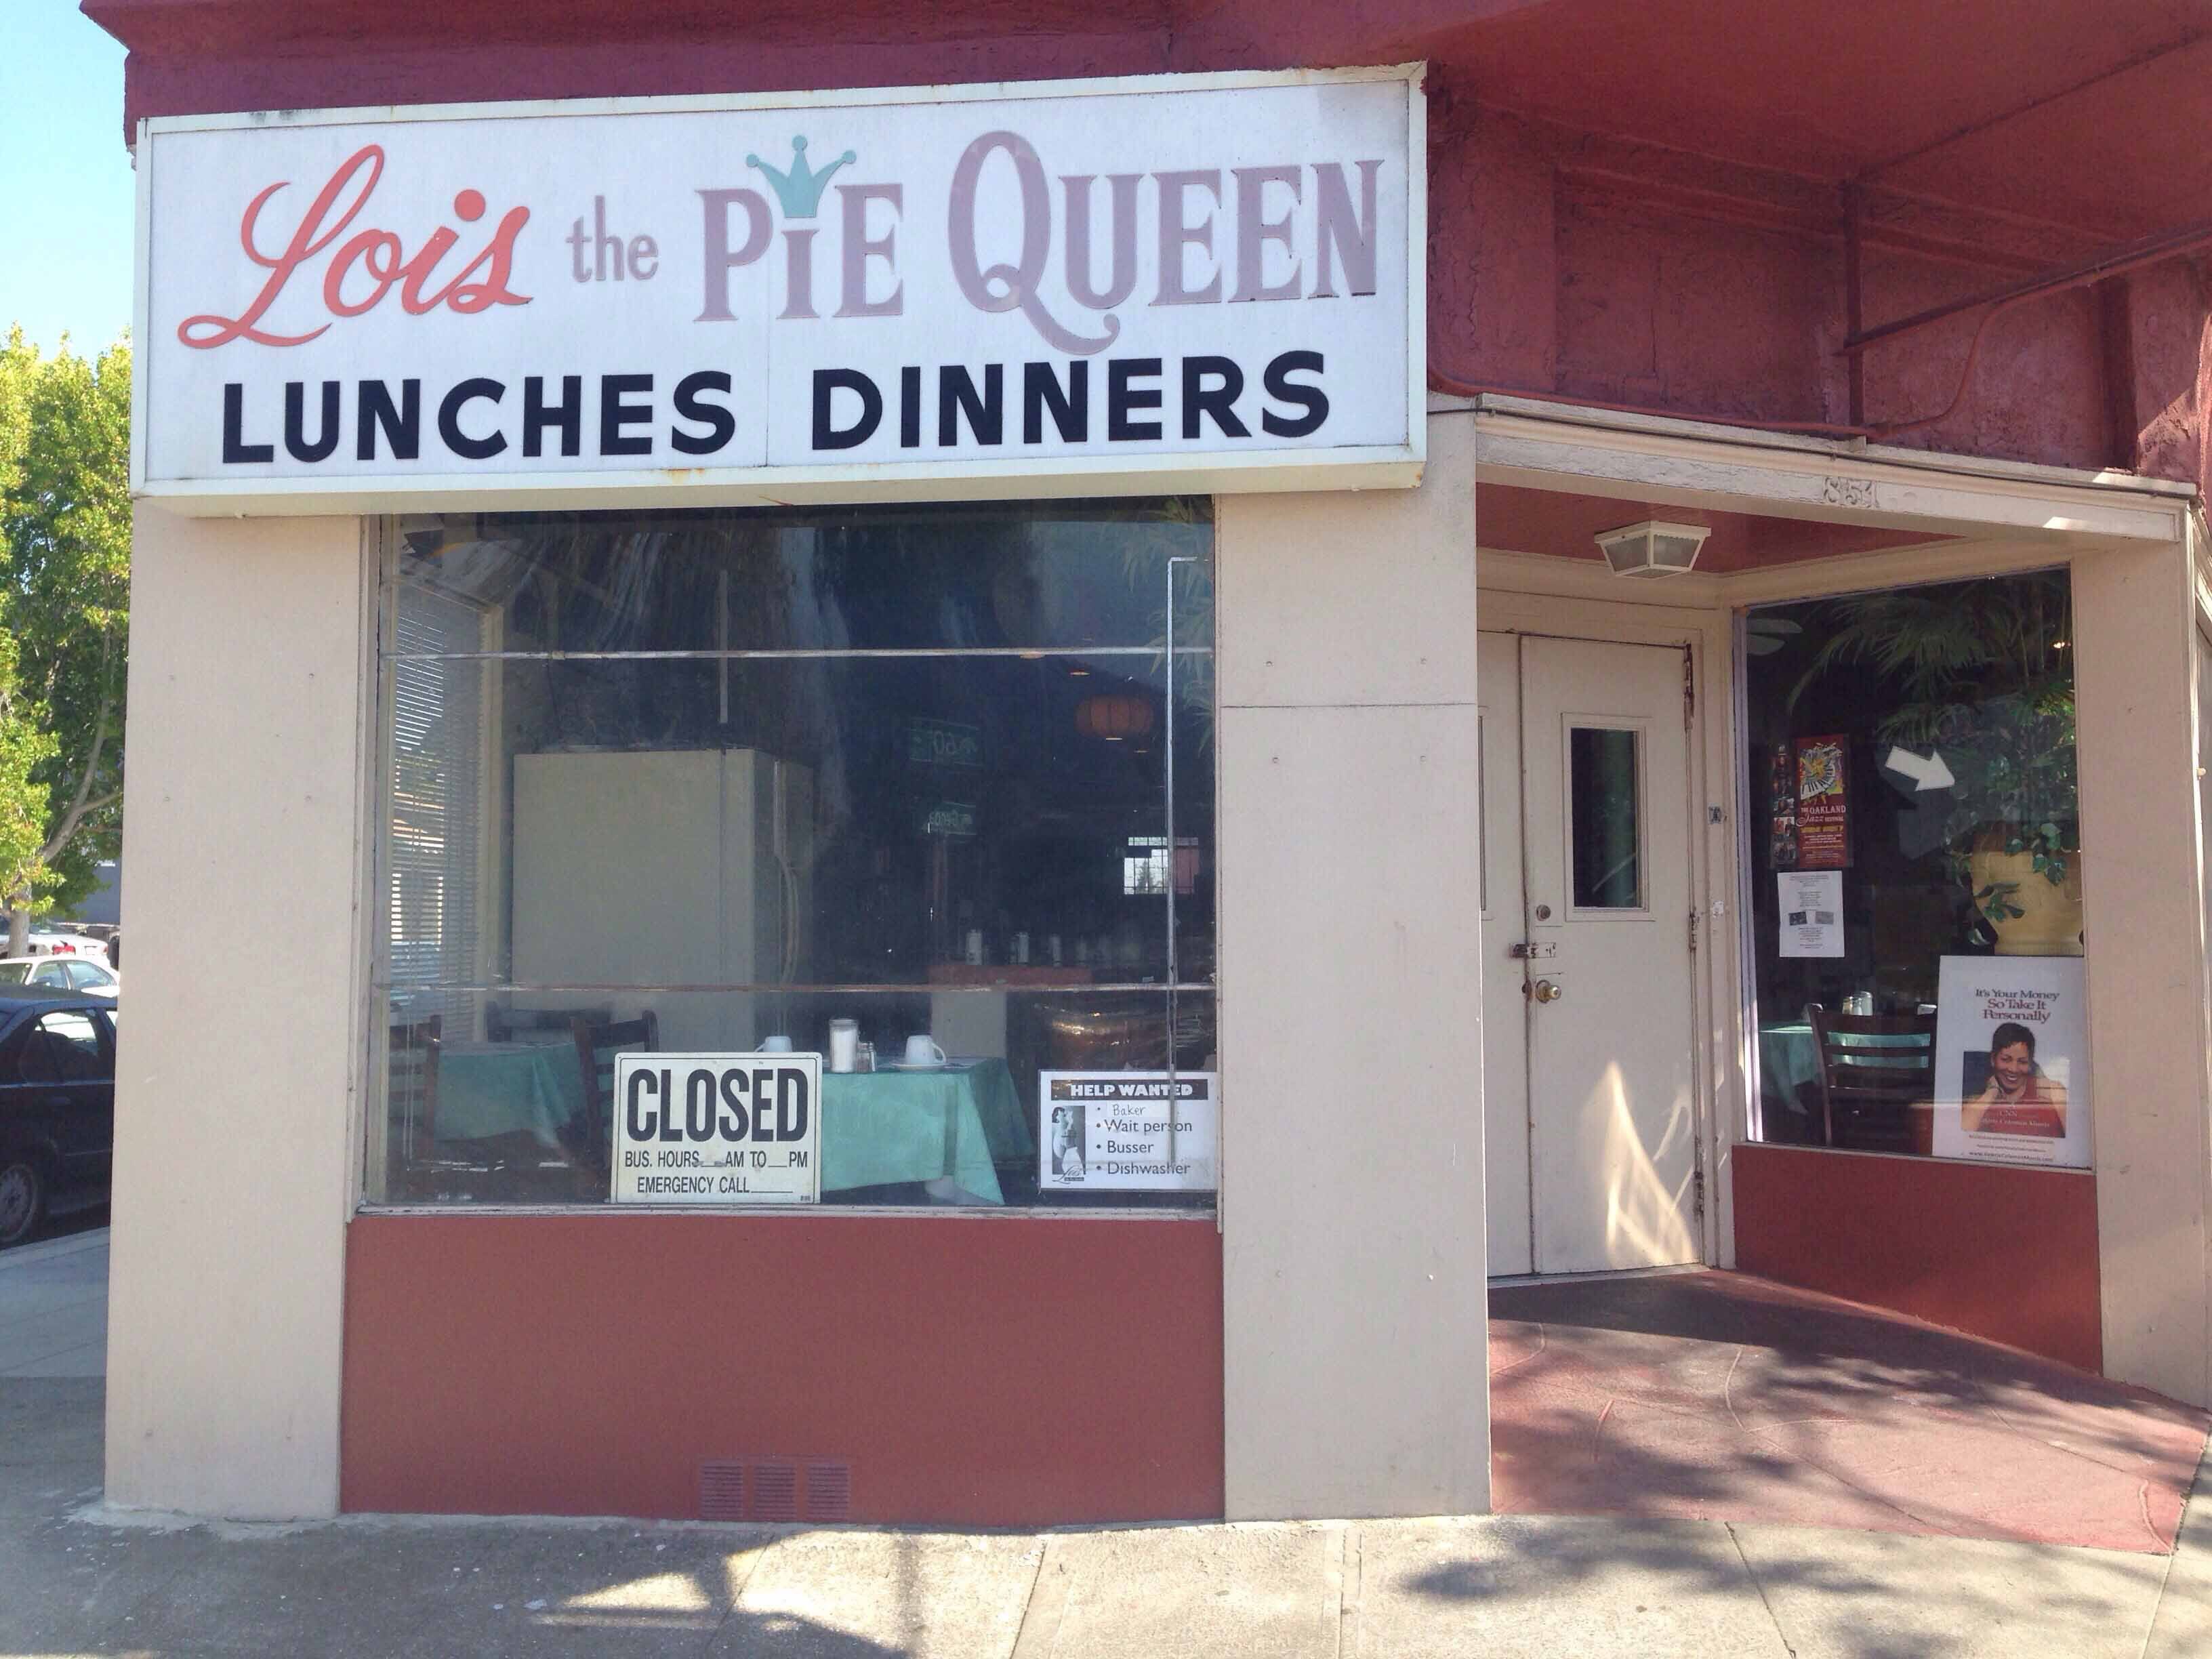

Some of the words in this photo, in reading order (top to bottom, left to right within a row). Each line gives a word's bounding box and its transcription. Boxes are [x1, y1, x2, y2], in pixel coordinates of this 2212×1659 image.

[178, 144, 533, 349] Lois
[565, 194, 659, 283] the
[948, 130, 1385, 355] QUEEN
[223, 371, 735, 464] LUNCHES
[812, 350, 1329, 450] DINNERS
[1809, 805, 1847, 815] OAKLAND
[1975, 989, 1990, 997] It's
[1992, 989, 2018, 998] Your
[2020, 990, 2060, 1001] Money
[1988, 998, 2005, 1008] So
[2005, 999, 2034, 1009] Take
[2037, 1000, 2046, 1009] It
[1983, 1009, 2051, 1023] Personally
[1070, 1084, 1115, 1097] HELP
[1120, 1084, 1193, 1097] WANTED
[627, 1068, 808, 1142] CLOSED
[1113, 1104, 1146, 1117] Baker
[1104, 1119, 1139, 1132] Wait
[1143, 1122, 1192, 1136] person
[1107, 1141, 1153, 1153] Busser
[625, 1151, 653, 1168] BUS.
[657, 1151, 699, 1168] HOURS
[725, 1151, 744, 1168] AM
[750, 1151, 766, 1168] TO
[789, 1151, 808, 1168] PM
[1108, 1162, 1191, 1174] Dishwasher
[637, 1176, 714, 1193] EMERGENCY
[719, 1176, 750, 1193] CALL
